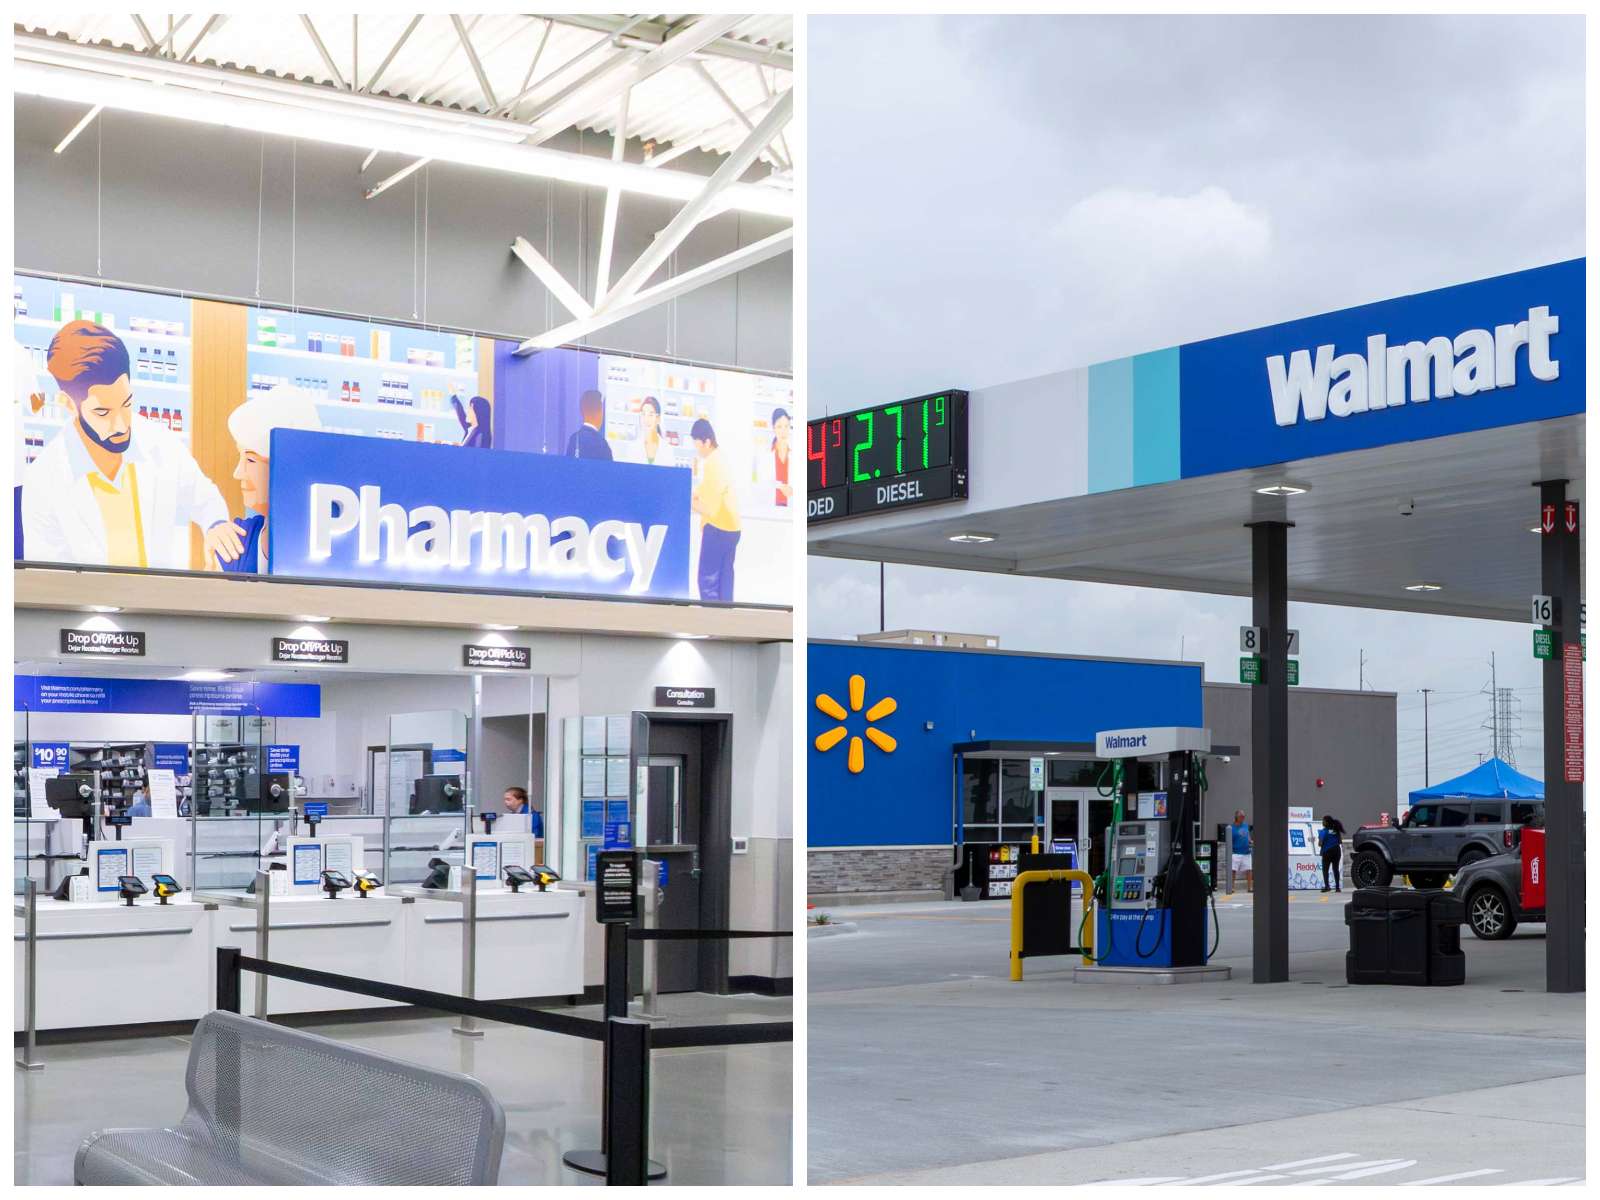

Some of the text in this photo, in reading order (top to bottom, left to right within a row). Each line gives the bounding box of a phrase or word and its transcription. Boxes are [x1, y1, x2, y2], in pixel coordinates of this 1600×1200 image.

[1266, 305, 1559, 427] Walmart
[877, 480, 923, 504] DIESEL
[807, 497, 834, 516] DED
[309, 483, 668, 593] Pharmacy
[1533, 599, 1550, 620] 16
[68, 633, 90, 646] Drop
[126, 635, 139, 647] Up
[1245, 630, 1255, 648] 8
[1536, 633, 1551, 644] DIESEL
[279, 641, 299, 653] Drop
[331, 643, 343, 655] Up
[469, 648, 487, 659] Drop
[515, 650, 526, 661] Up
[1242, 661, 1258, 670] DIESEL
[1244, 671, 1256, 681] HERE
[666, 689, 704, 698] Consultation
[1105, 734, 1147, 749] Walmart
[35, 747, 67, 761] $10 90
